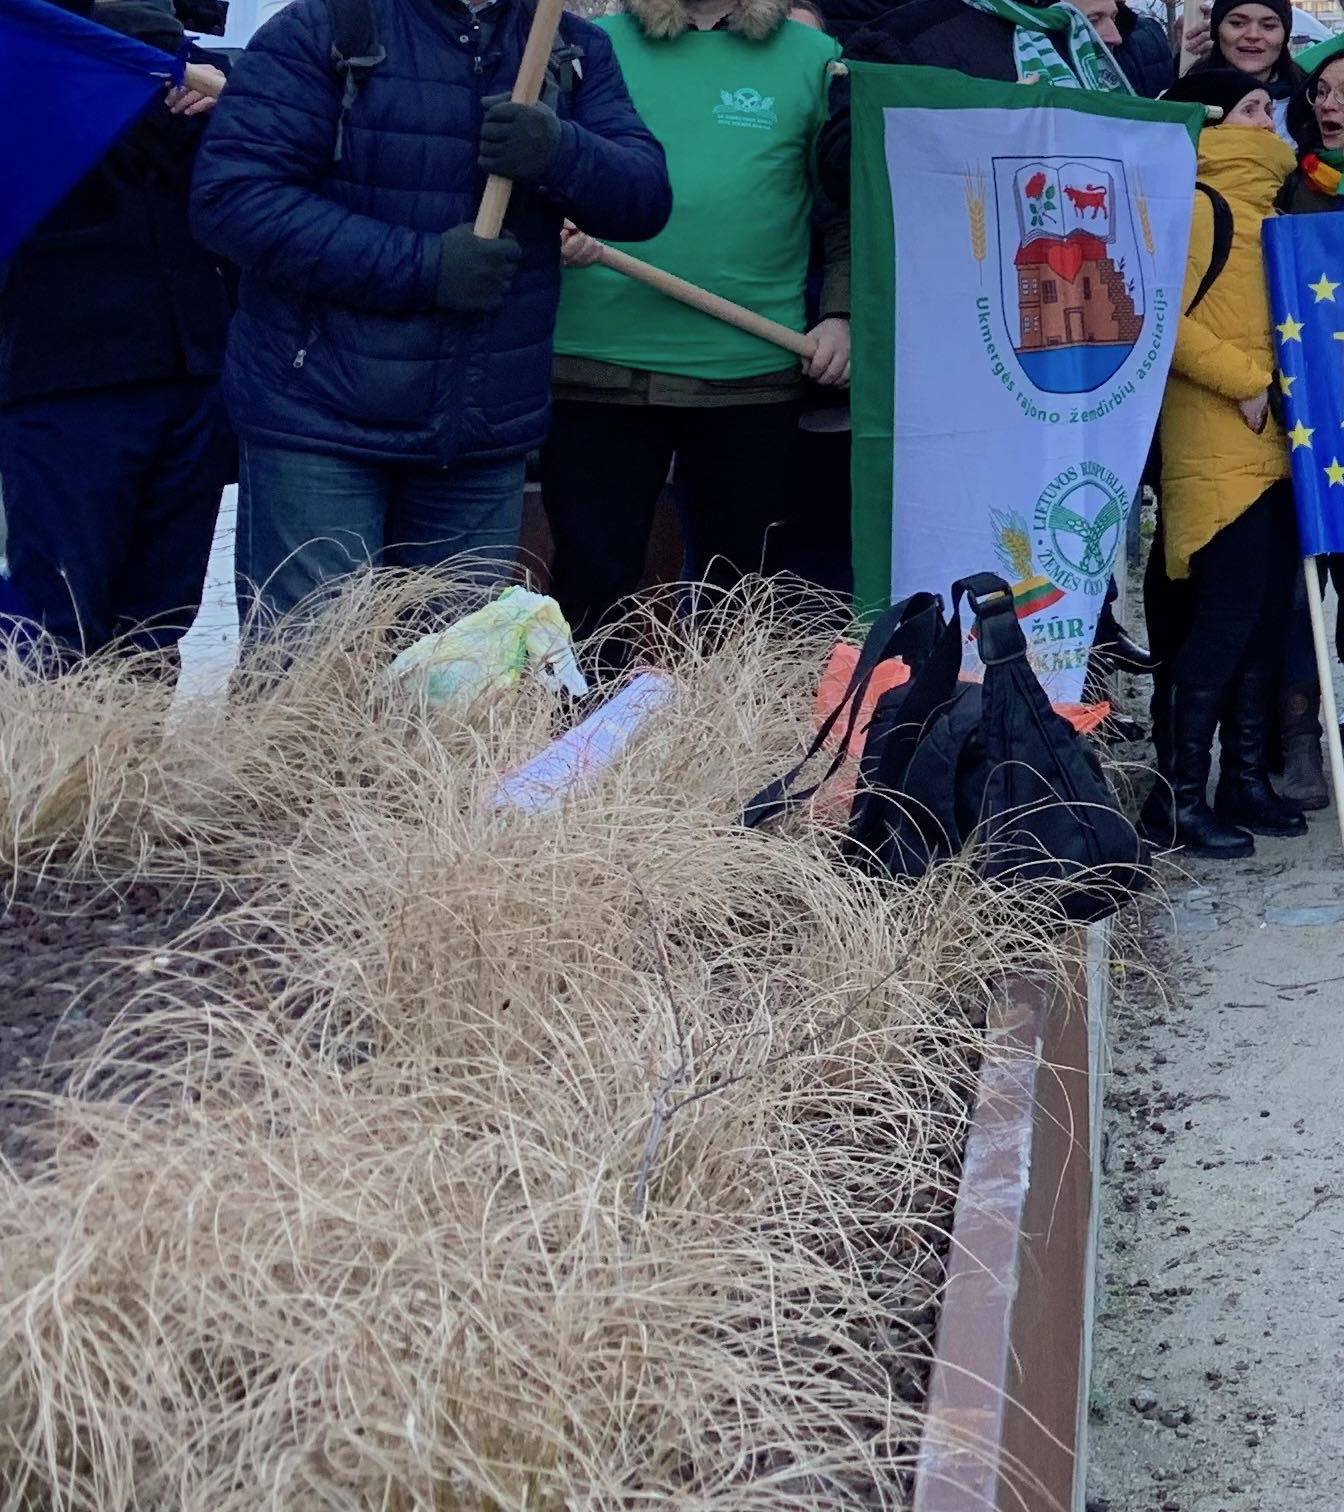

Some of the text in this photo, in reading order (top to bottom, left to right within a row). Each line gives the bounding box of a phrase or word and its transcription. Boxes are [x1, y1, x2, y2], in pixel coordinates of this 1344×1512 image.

[976, 296, 1015, 392] Ukmergės
[1016, 392, 1061, 424] rajono
[1136, 288, 1168, 380] asociacija
[1034, 466, 1079, 531] LIETUVOS
